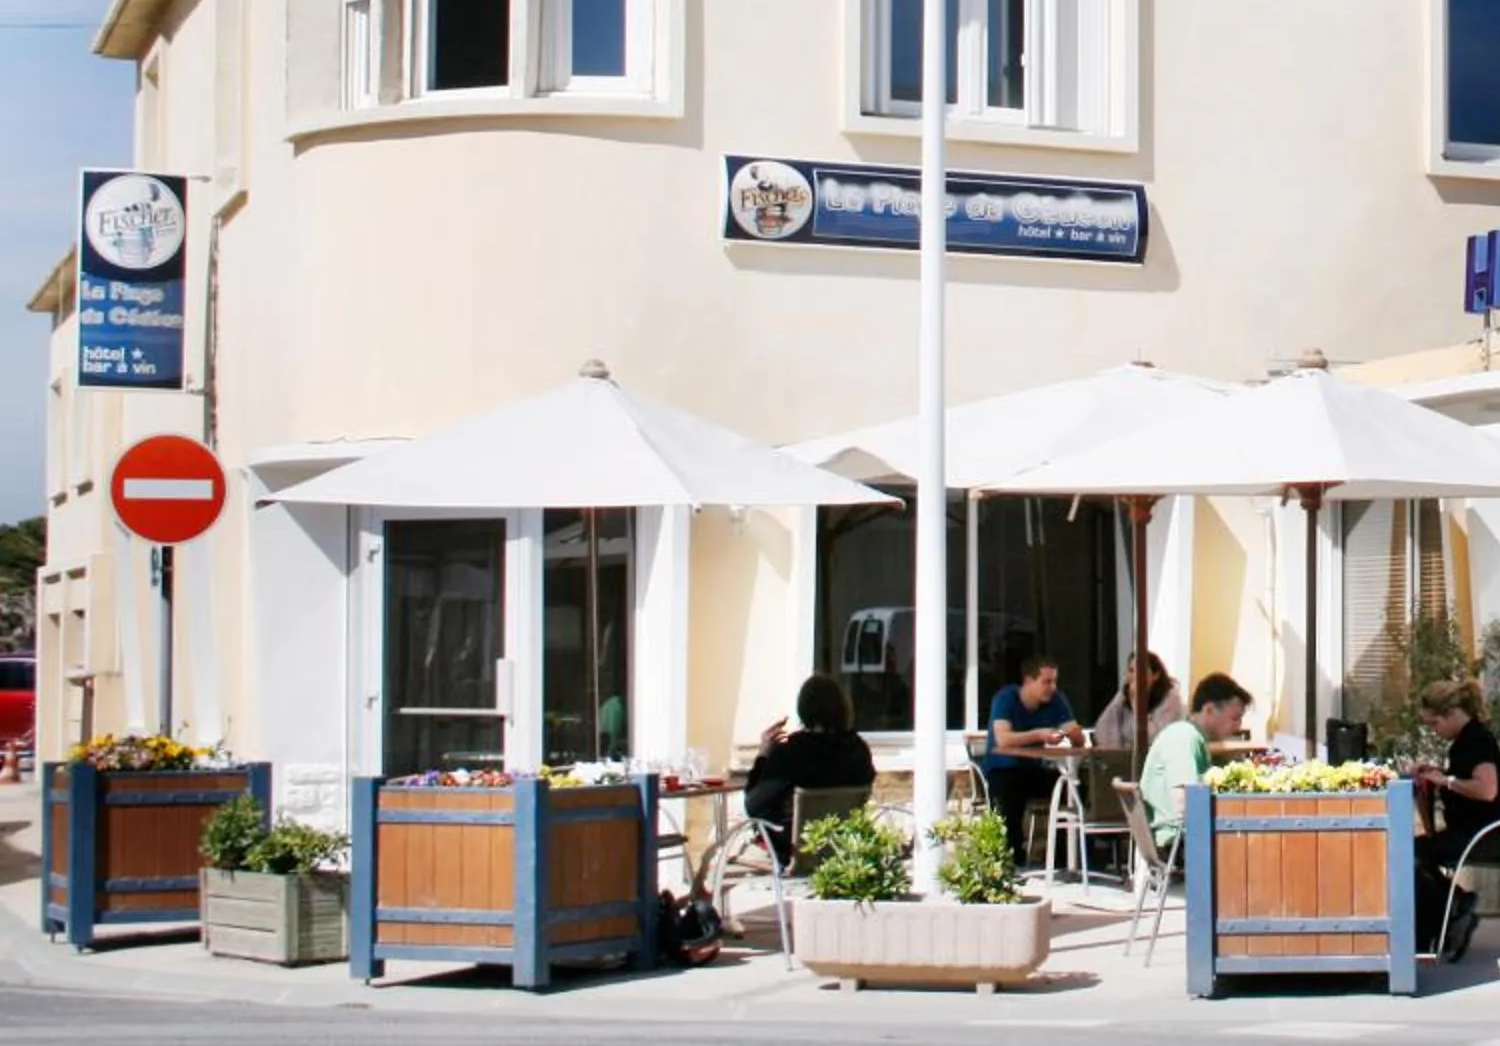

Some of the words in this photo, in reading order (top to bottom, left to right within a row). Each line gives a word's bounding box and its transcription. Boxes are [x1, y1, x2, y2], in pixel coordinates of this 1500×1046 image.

[824, 178, 865, 212] La
[869, 181, 958, 220] Plae
[80, 280, 106, 301] La
[83, 345, 126, 362] hôtel
[83, 359, 112, 373] bar
[132, 360, 157, 375] vin
